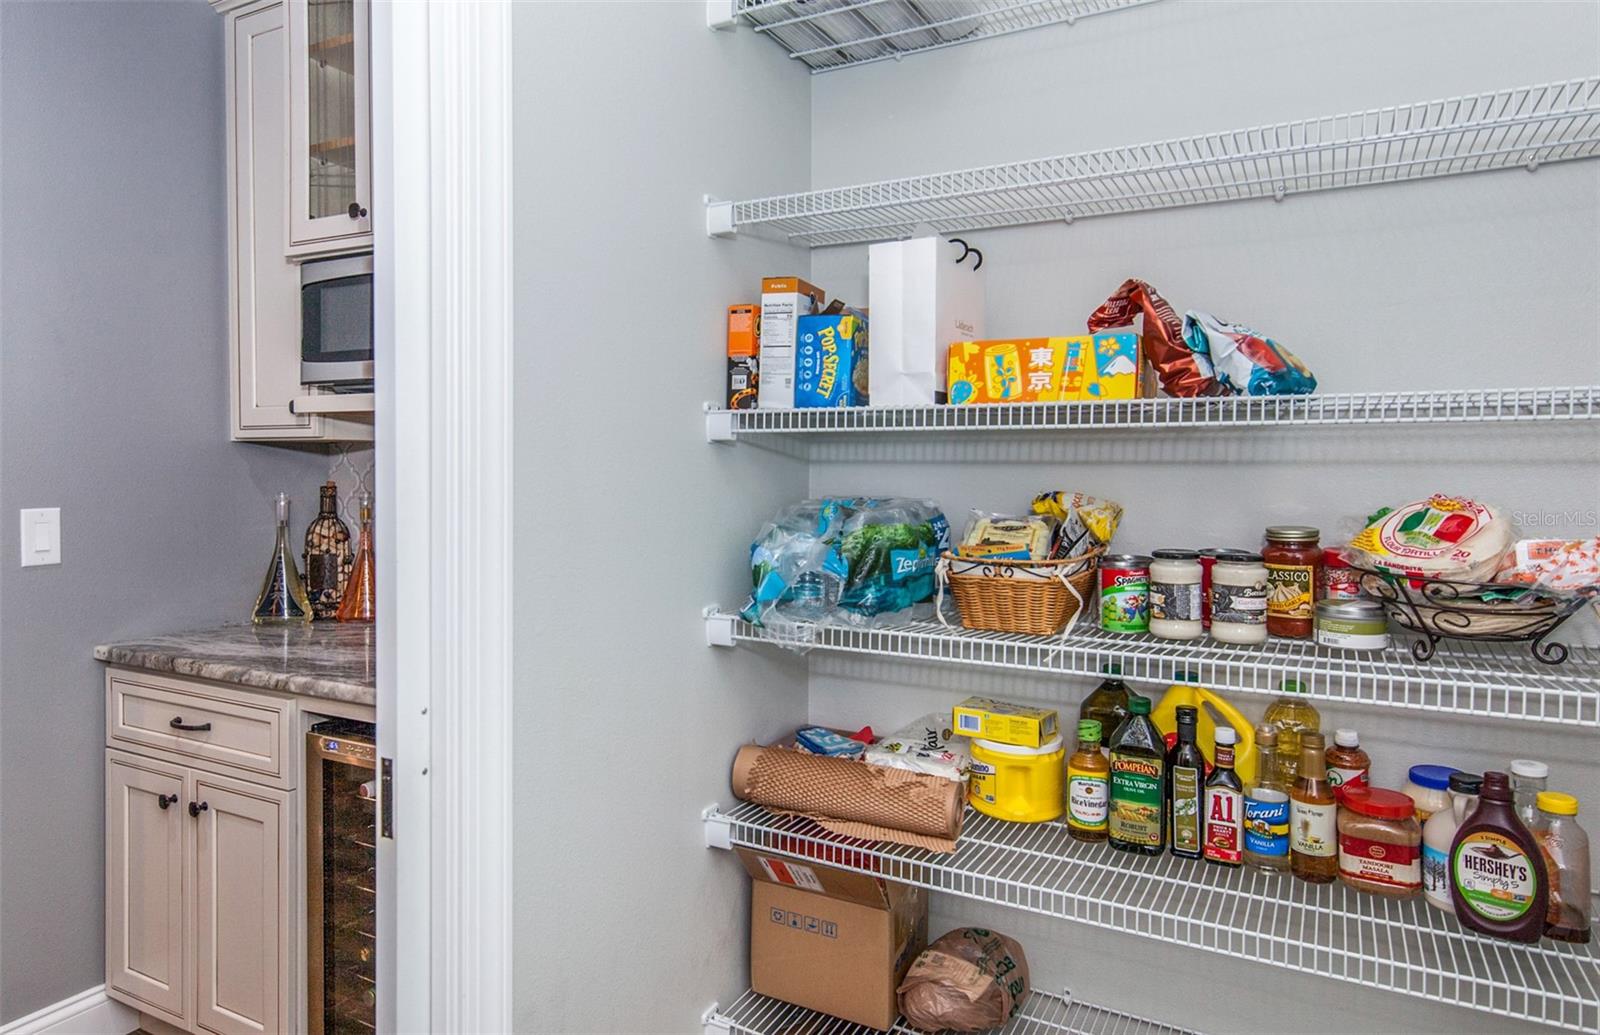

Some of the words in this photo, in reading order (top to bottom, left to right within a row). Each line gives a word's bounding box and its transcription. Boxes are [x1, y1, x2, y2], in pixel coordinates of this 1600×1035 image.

[1268, 570, 1309, 582] LASSICO
[1114, 761, 1156, 775] POMPEIAN
[1113, 776, 1133, 787] EXTRA
[1244, 801, 1284, 819] Torani
[1249, 838, 1275, 847] VANILLA
[1464, 854, 1527, 881] HERSHEY'S
